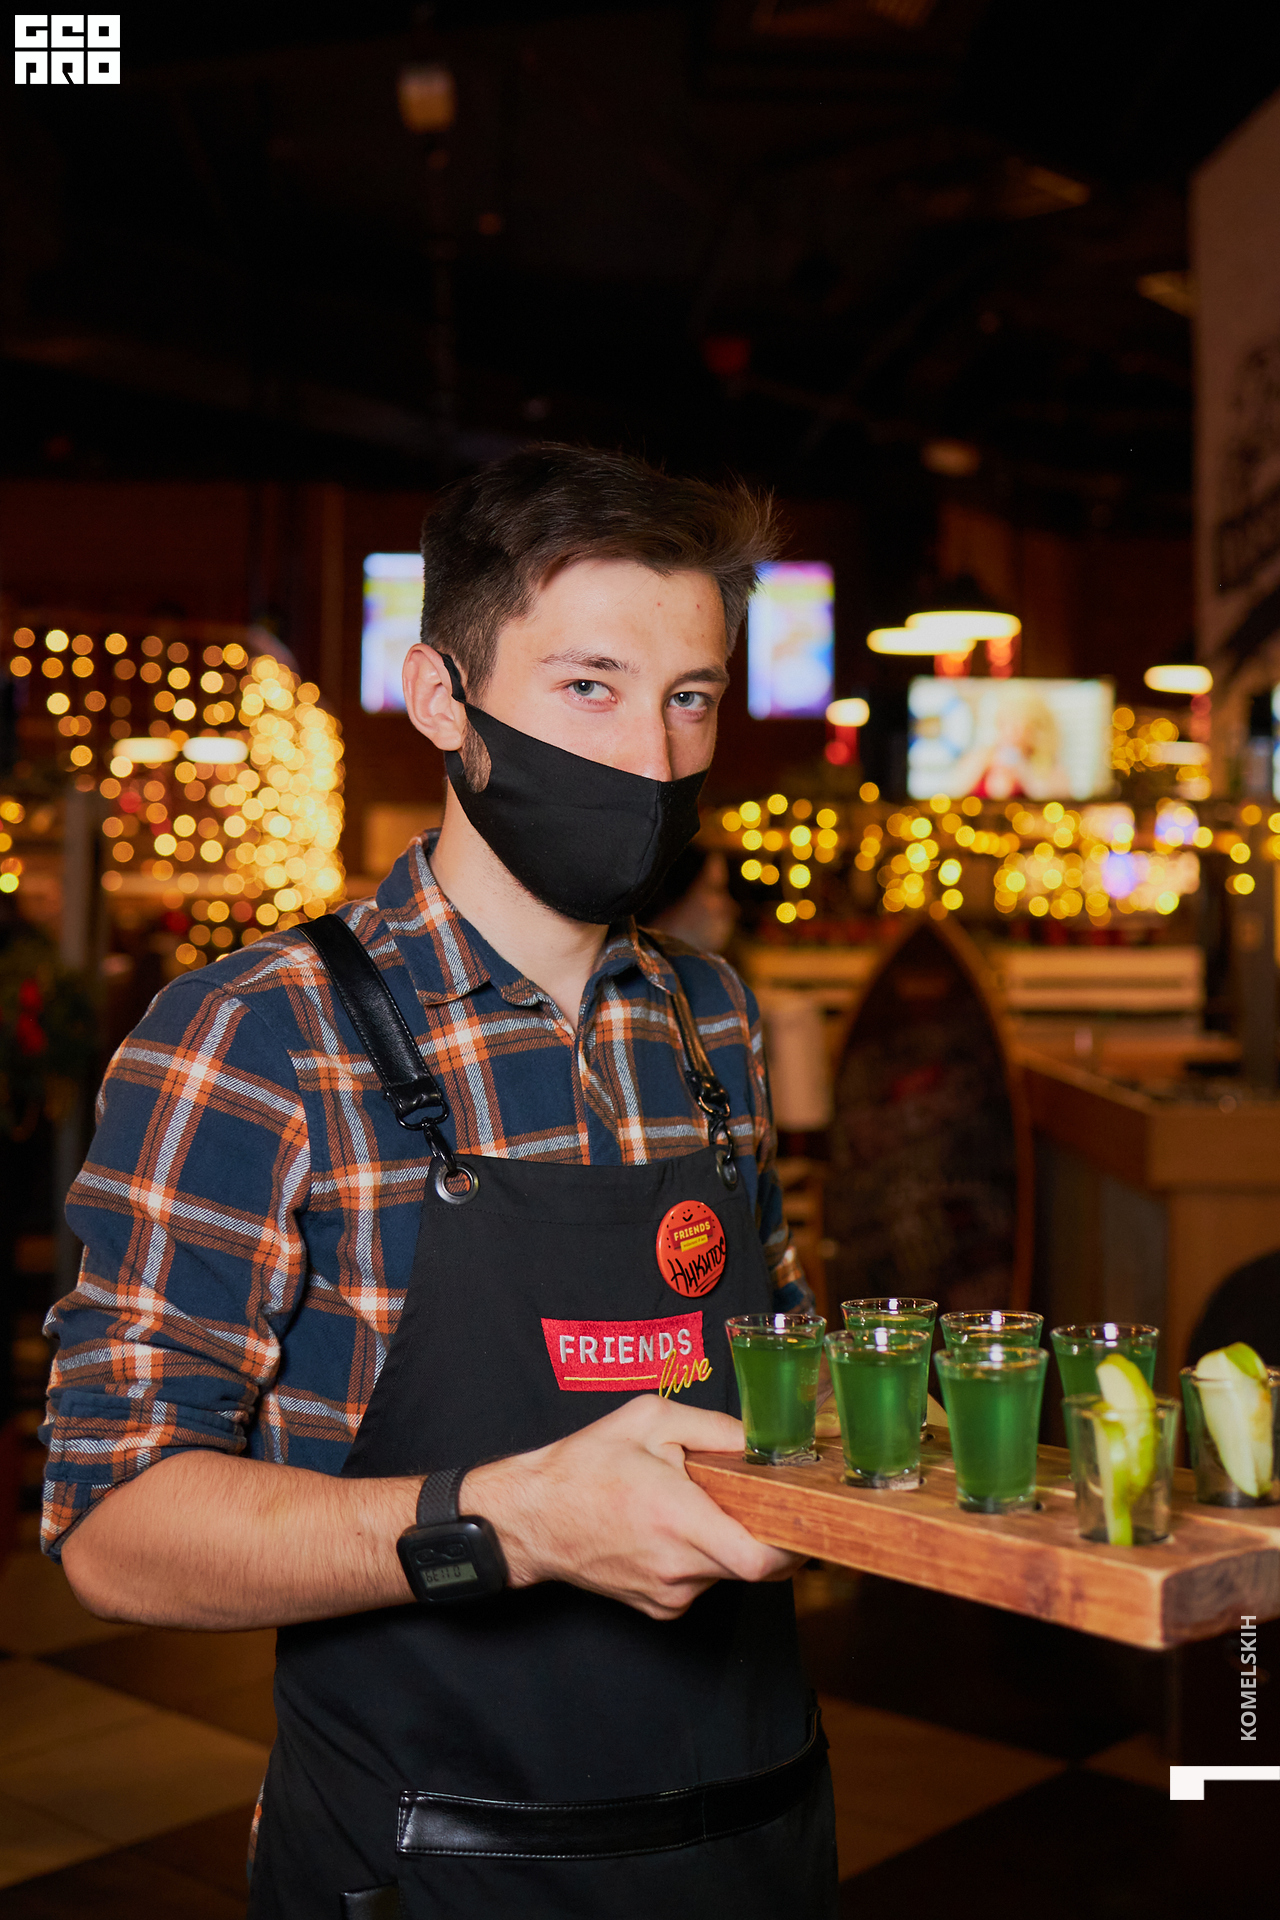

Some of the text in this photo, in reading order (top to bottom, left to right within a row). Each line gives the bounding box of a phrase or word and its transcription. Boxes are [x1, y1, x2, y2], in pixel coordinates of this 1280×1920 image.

[674, 1221, 711, 1242] FRIENDS
[559, 1328, 693, 1364] FRIENDS
[659, 1348, 714, 1398] live
